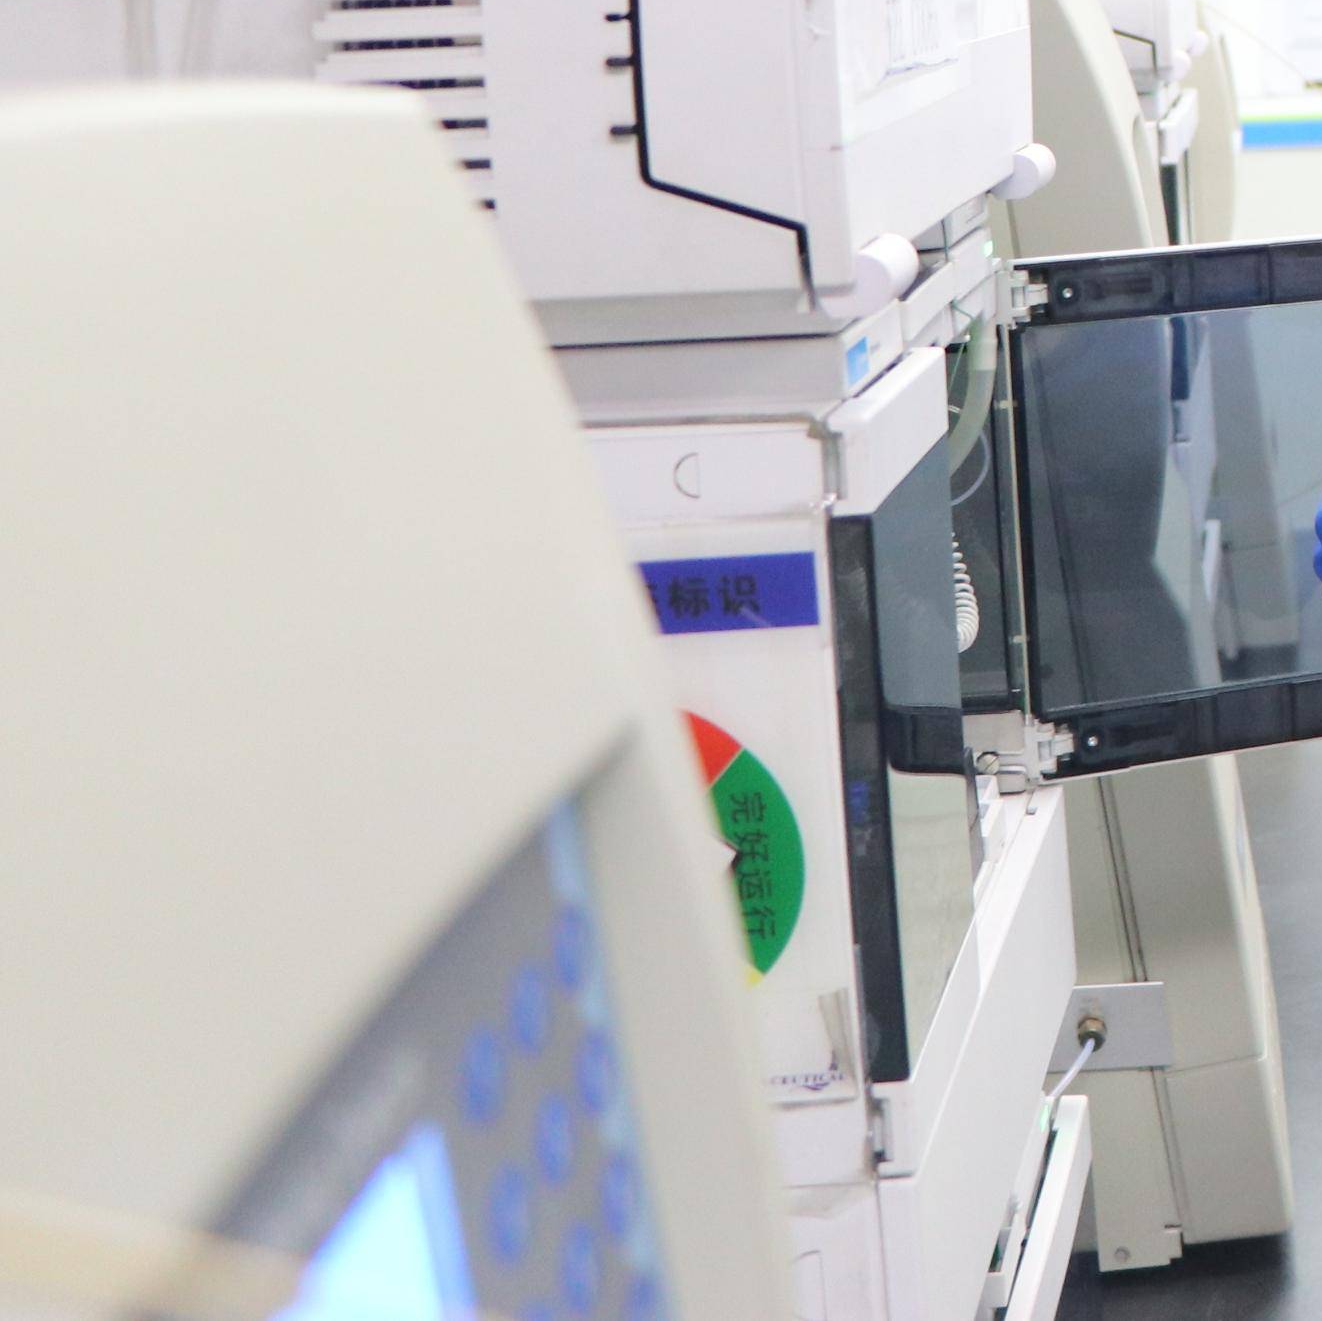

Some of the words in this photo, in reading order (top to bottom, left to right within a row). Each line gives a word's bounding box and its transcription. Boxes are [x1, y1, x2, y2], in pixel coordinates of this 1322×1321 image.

[646, 574, 761, 619] 标识
[730, 790, 777, 940] 完好运行
